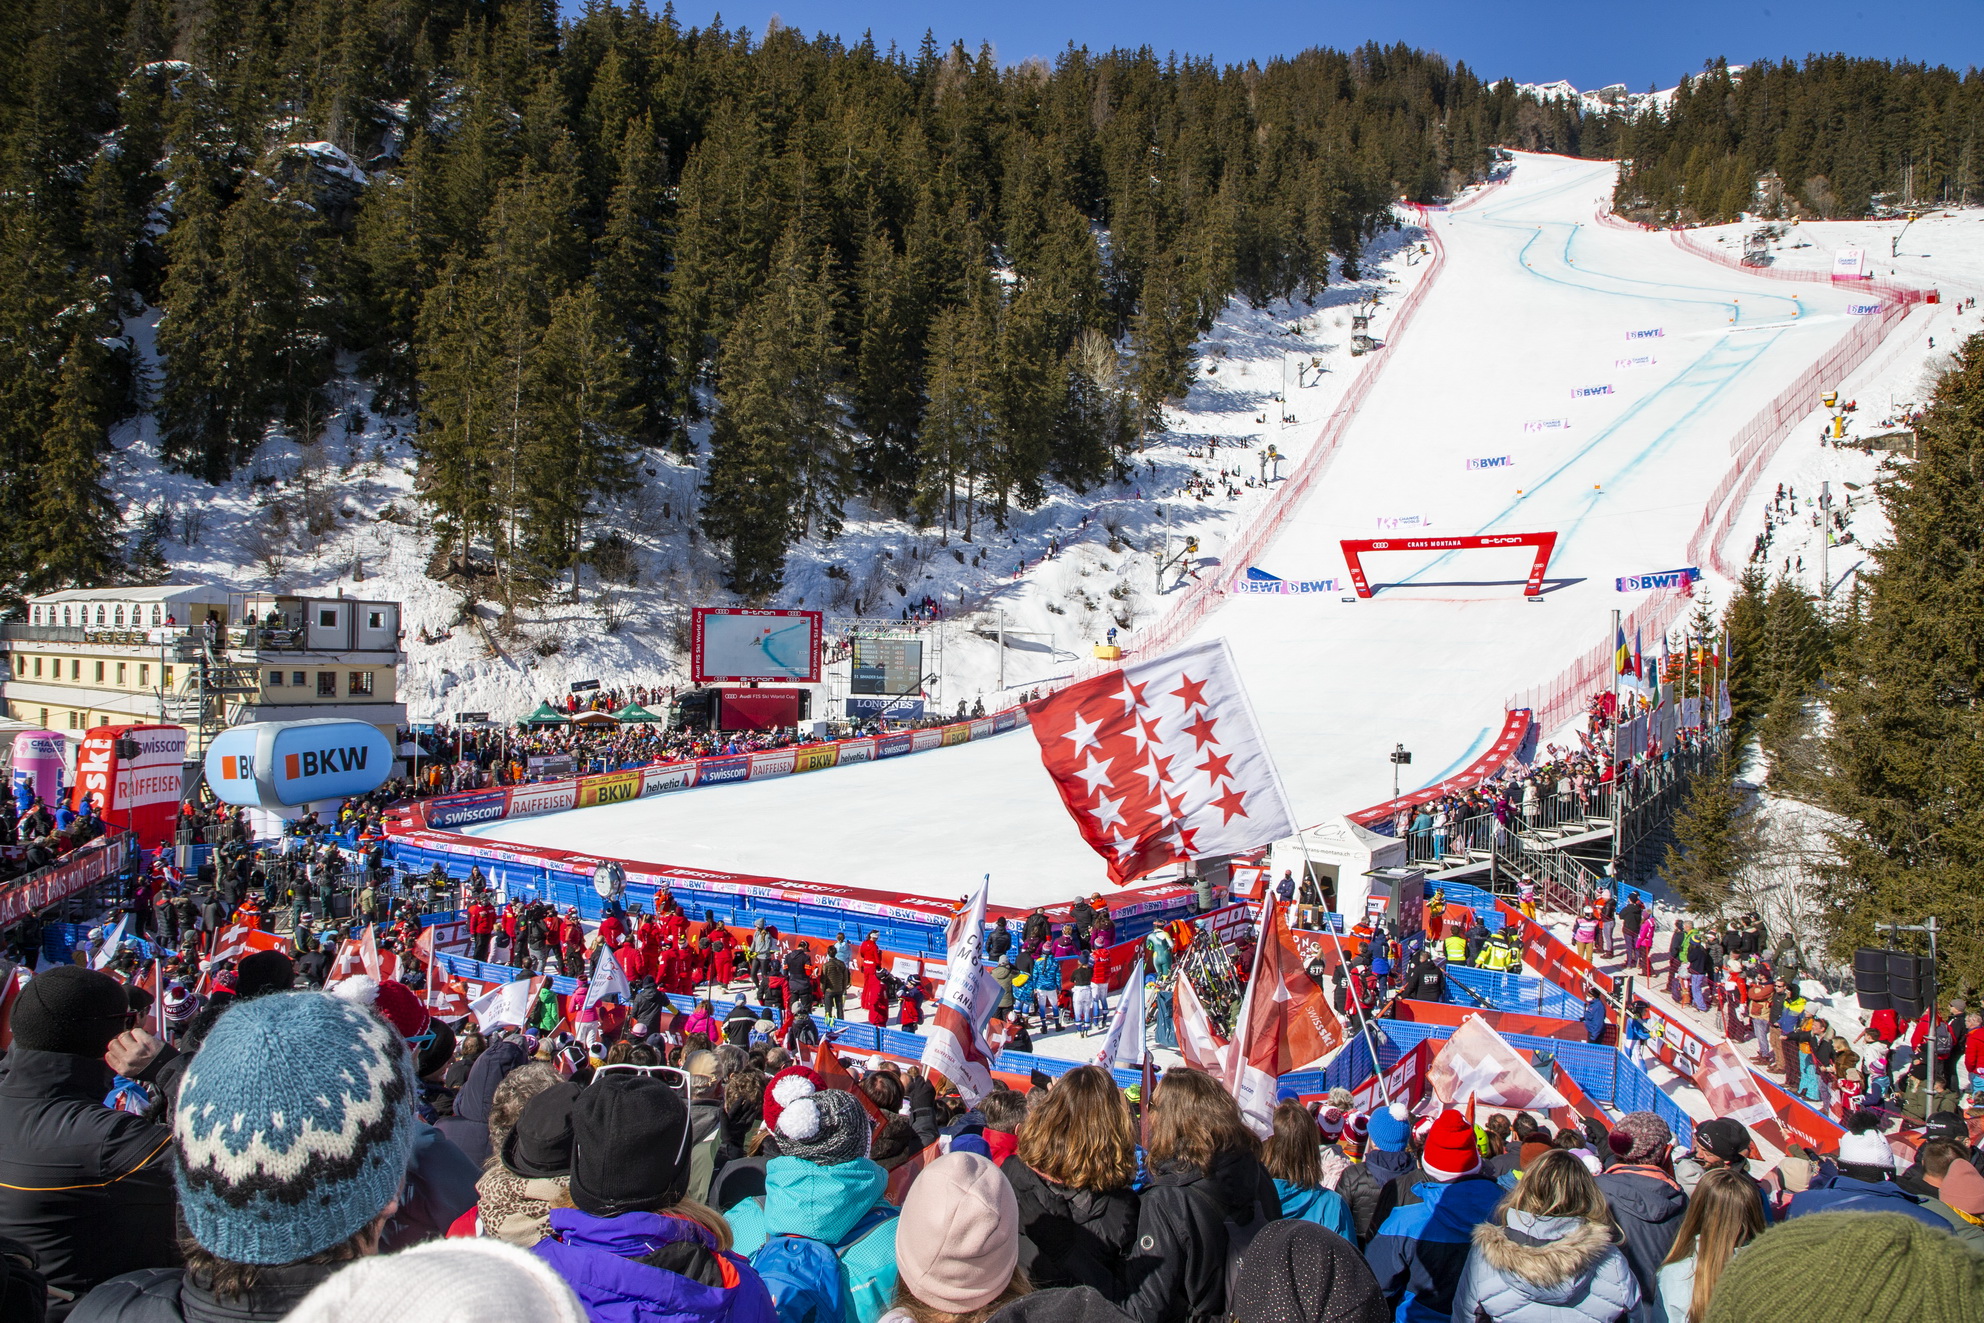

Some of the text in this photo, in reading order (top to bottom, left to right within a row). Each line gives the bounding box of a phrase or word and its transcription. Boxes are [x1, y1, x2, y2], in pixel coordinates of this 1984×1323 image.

[1857, 305, 1878, 314] BWT
[1637, 329, 1659, 339] BWT
[1583, 386, 1608, 397] BWT
[1480, 456, 1507, 468] BWT
[1480, 536, 1522, 544] e-tron
[1250, 581, 1282, 592] BWT
[1300, 580, 1332, 592] BWT
[1641, 574, 1679, 589] BWT
[857, 700, 914, 709] LONGINES
[884, 742, 910, 756] swisscom
[914, 737, 942, 750] RAIFFEISEN
[303, 746, 368, 776] BKW
[810, 754, 832, 770] BKW
[840, 752, 864, 762] helvetia
[710, 766, 747, 781] swisscom
[752, 762, 792, 776] RAIFFEISEN
[118, 776, 182, 798] RAIFFEISEN
[646, 779, 680, 793] helvetia
[598, 783, 632, 802] BKW
[512, 794, 573, 814] RAIFFEISEN
[445, 806, 502, 824] swisscom
[69, 867, 84, 892] MON
[689, 880, 706, 890] BWT
[752, 888, 772, 896] BWT
[822, 896, 842, 908] BWT
[895, 909, 916, 920] BWT
[1122, 906, 1138, 916] BWT
[934, 916, 952, 926] BW
